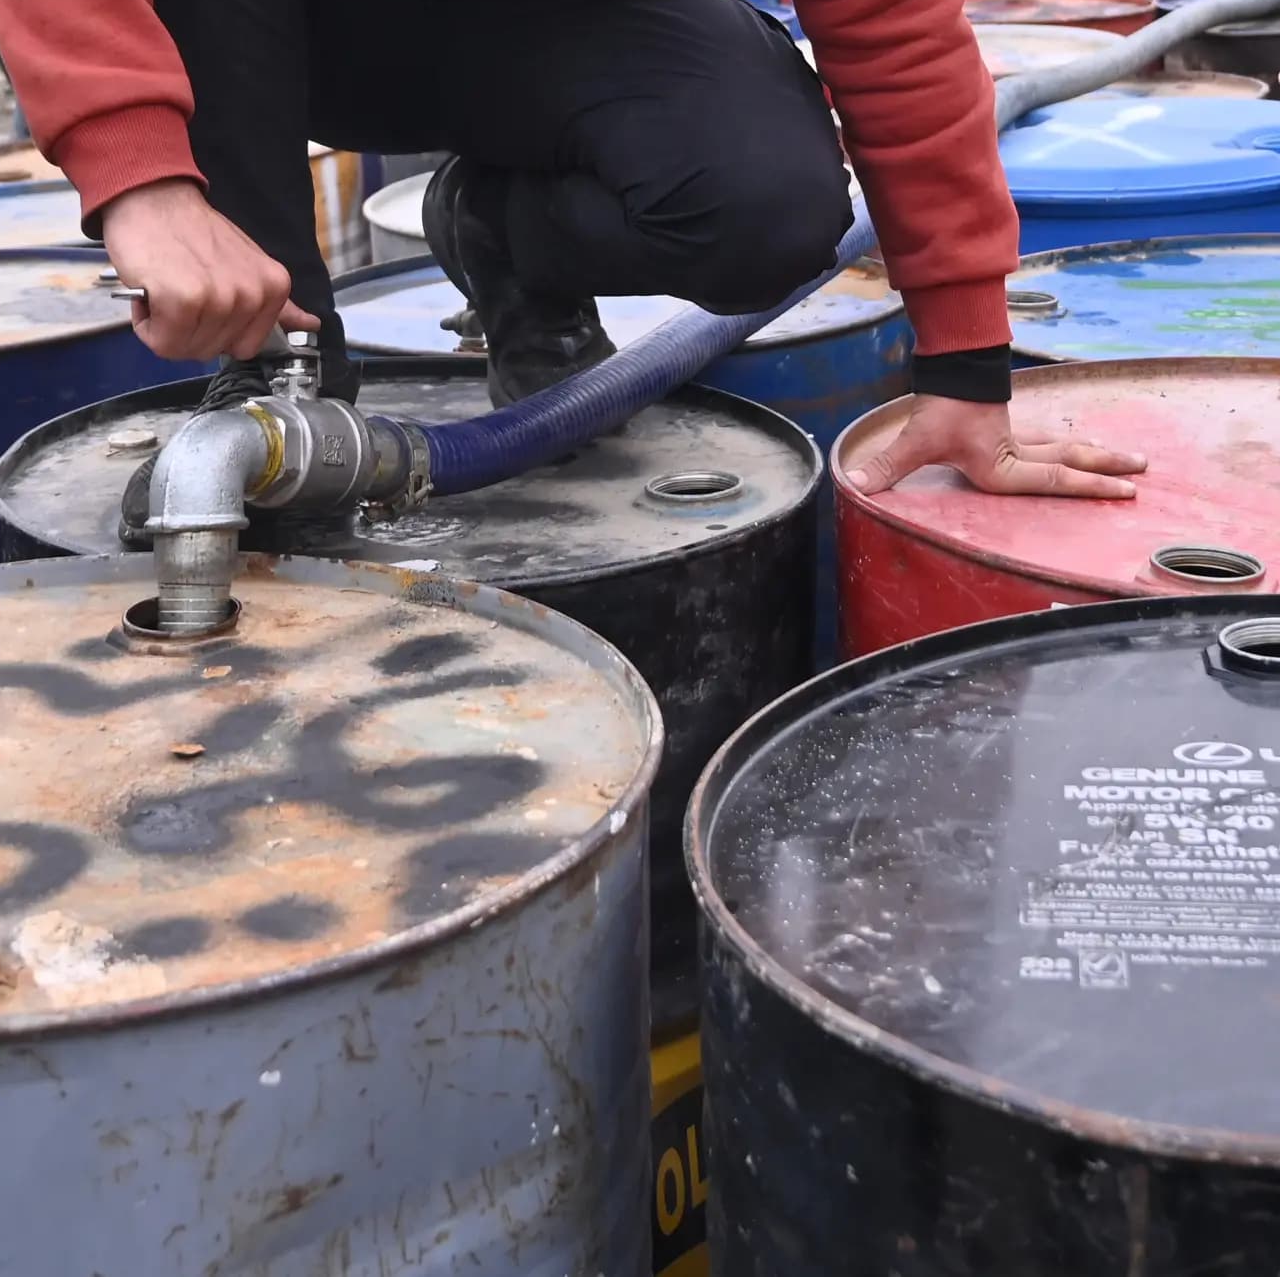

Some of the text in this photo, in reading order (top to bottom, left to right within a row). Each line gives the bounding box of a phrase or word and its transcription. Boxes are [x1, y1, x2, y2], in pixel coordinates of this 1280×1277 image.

[1081, 767, 1267, 785] GENUINE
[1063, 785, 1212, 802] MOTOR
[1077, 800, 1176, 815] Approved
[1144, 812, 1276, 831] 5W-40
[1129, 828, 1239, 845] API SN
[1059, 839, 1141, 858] Fuy
[1119, 869, 1150, 880] OIL
